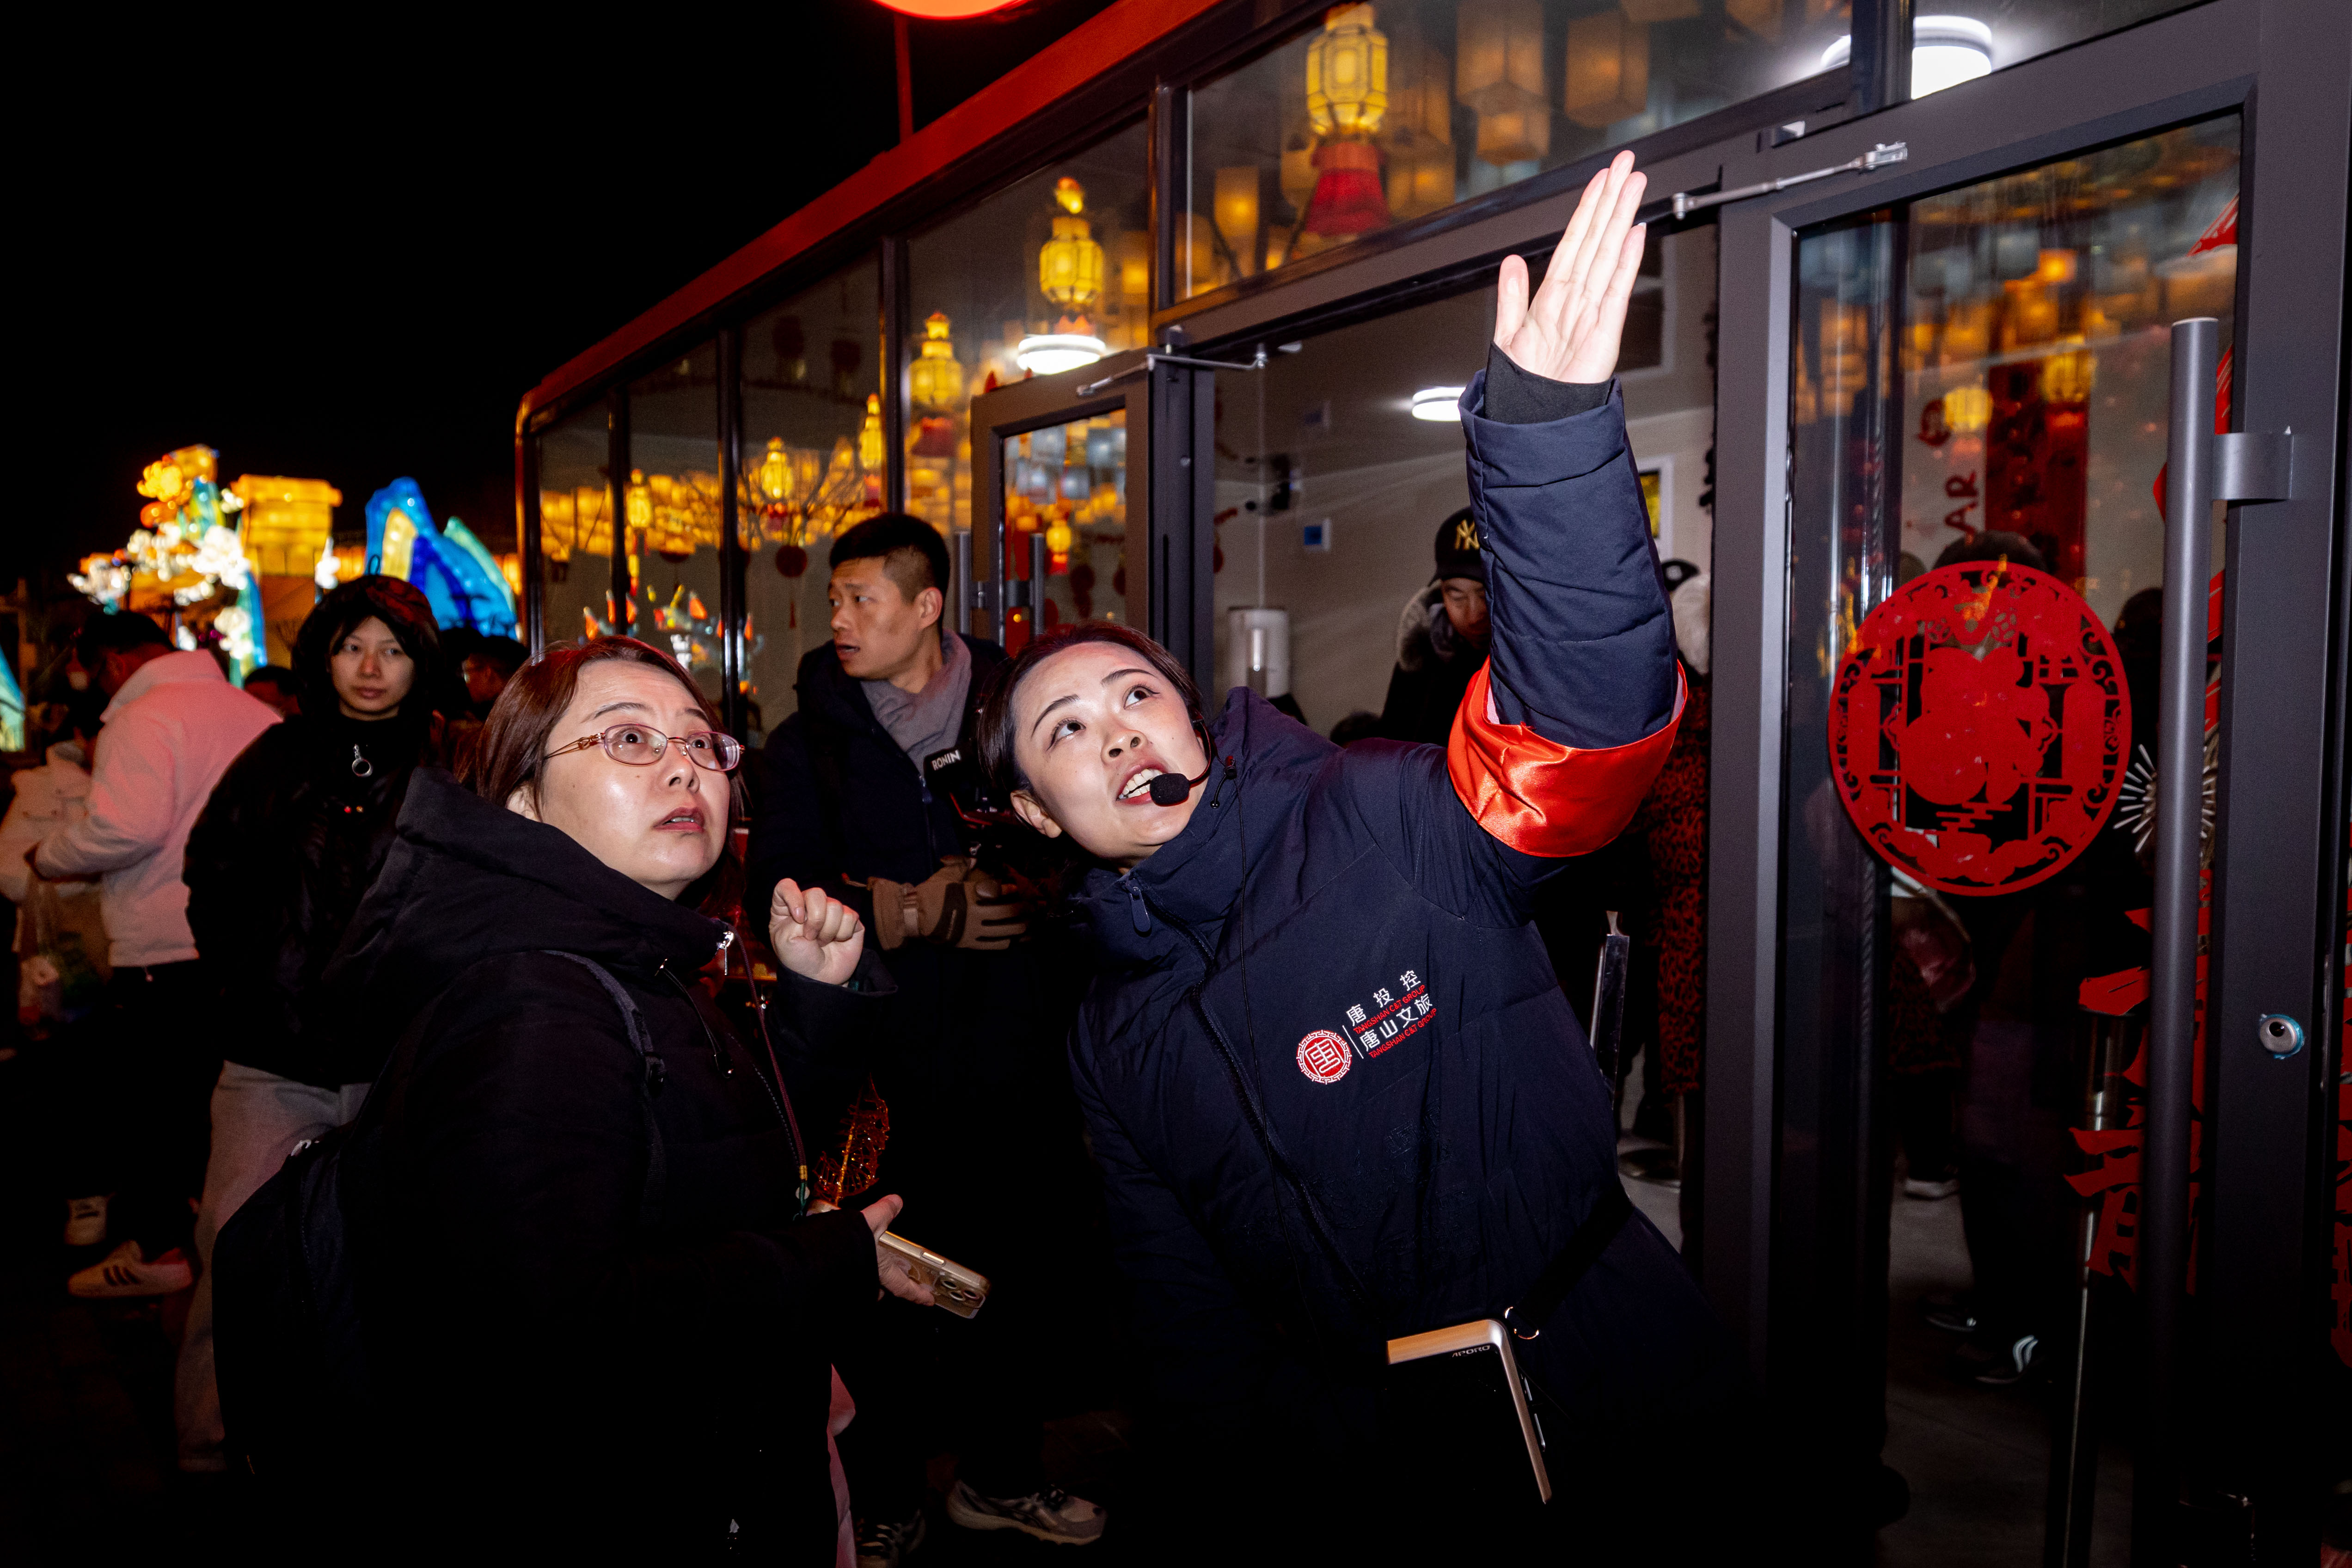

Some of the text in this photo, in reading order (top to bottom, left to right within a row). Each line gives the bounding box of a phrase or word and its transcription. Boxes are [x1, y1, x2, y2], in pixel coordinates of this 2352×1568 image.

[931, 749, 961, 771] RONIN
[1346, 970, 1421, 1026] 唐投控
[1353, 985, 1425, 1034] TANGSHAN C&T GROUP
[1360, 993, 1433, 1052] 唐山文旅
[1368, 1008, 1437, 1058] TANGSHAN C&T GROUP
[1452, 1345, 1490, 1358] APORO
